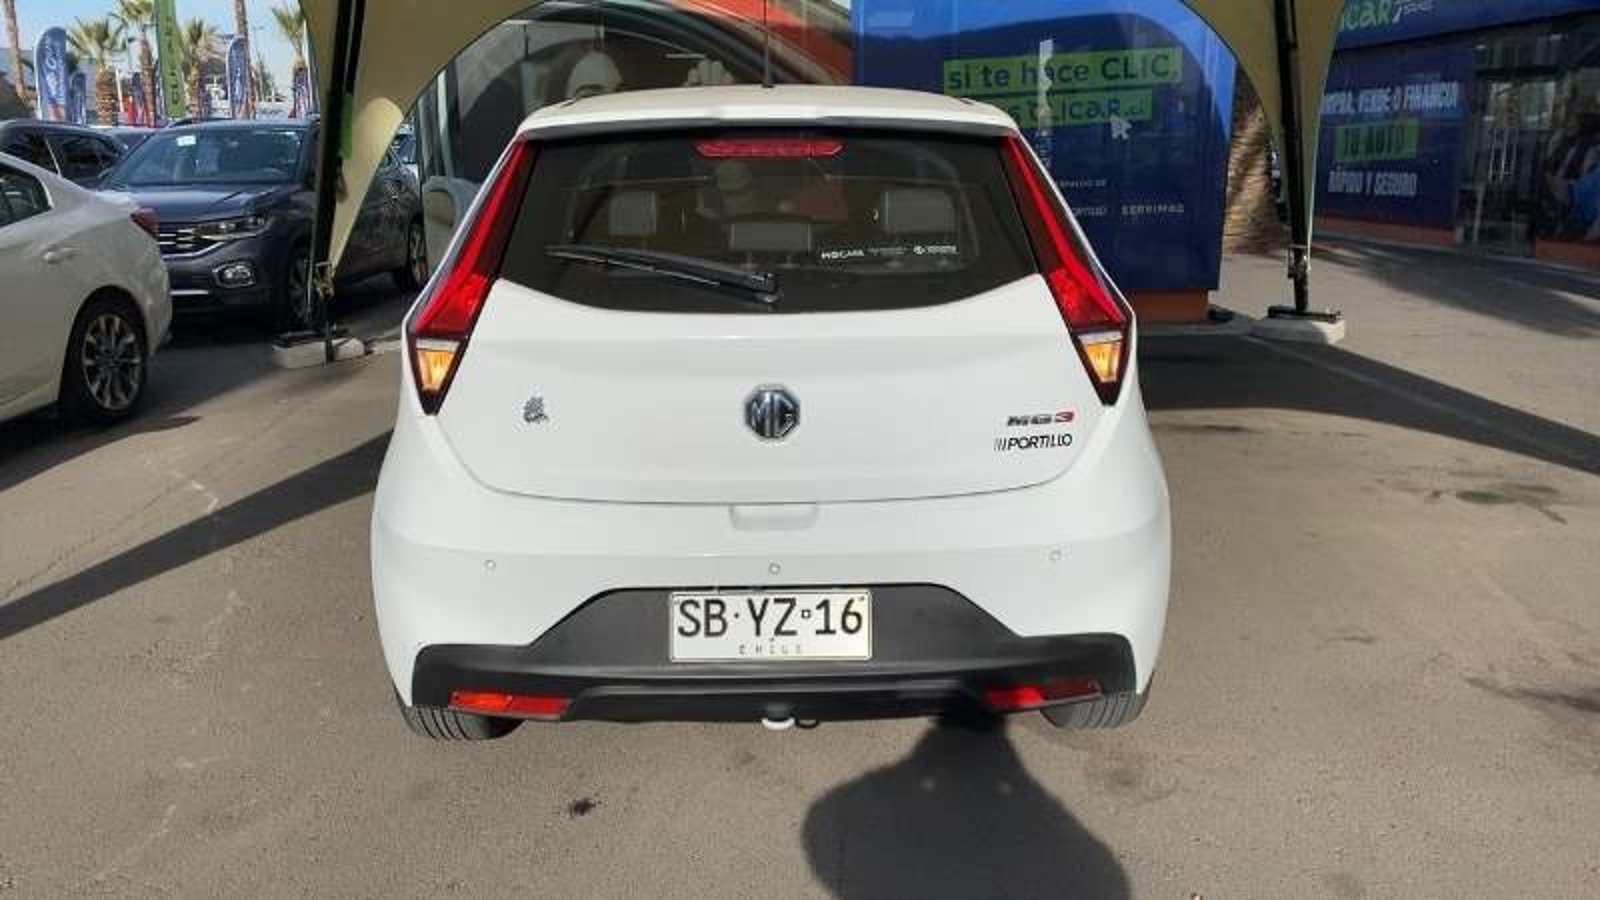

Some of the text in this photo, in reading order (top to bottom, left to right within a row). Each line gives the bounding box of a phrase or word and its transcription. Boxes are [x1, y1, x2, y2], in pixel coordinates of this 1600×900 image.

[949, 68, 970, 91] si
[981, 67, 1009, 89] te
[1021, 62, 1089, 86] hace
[751, 392, 793, 437] MG
